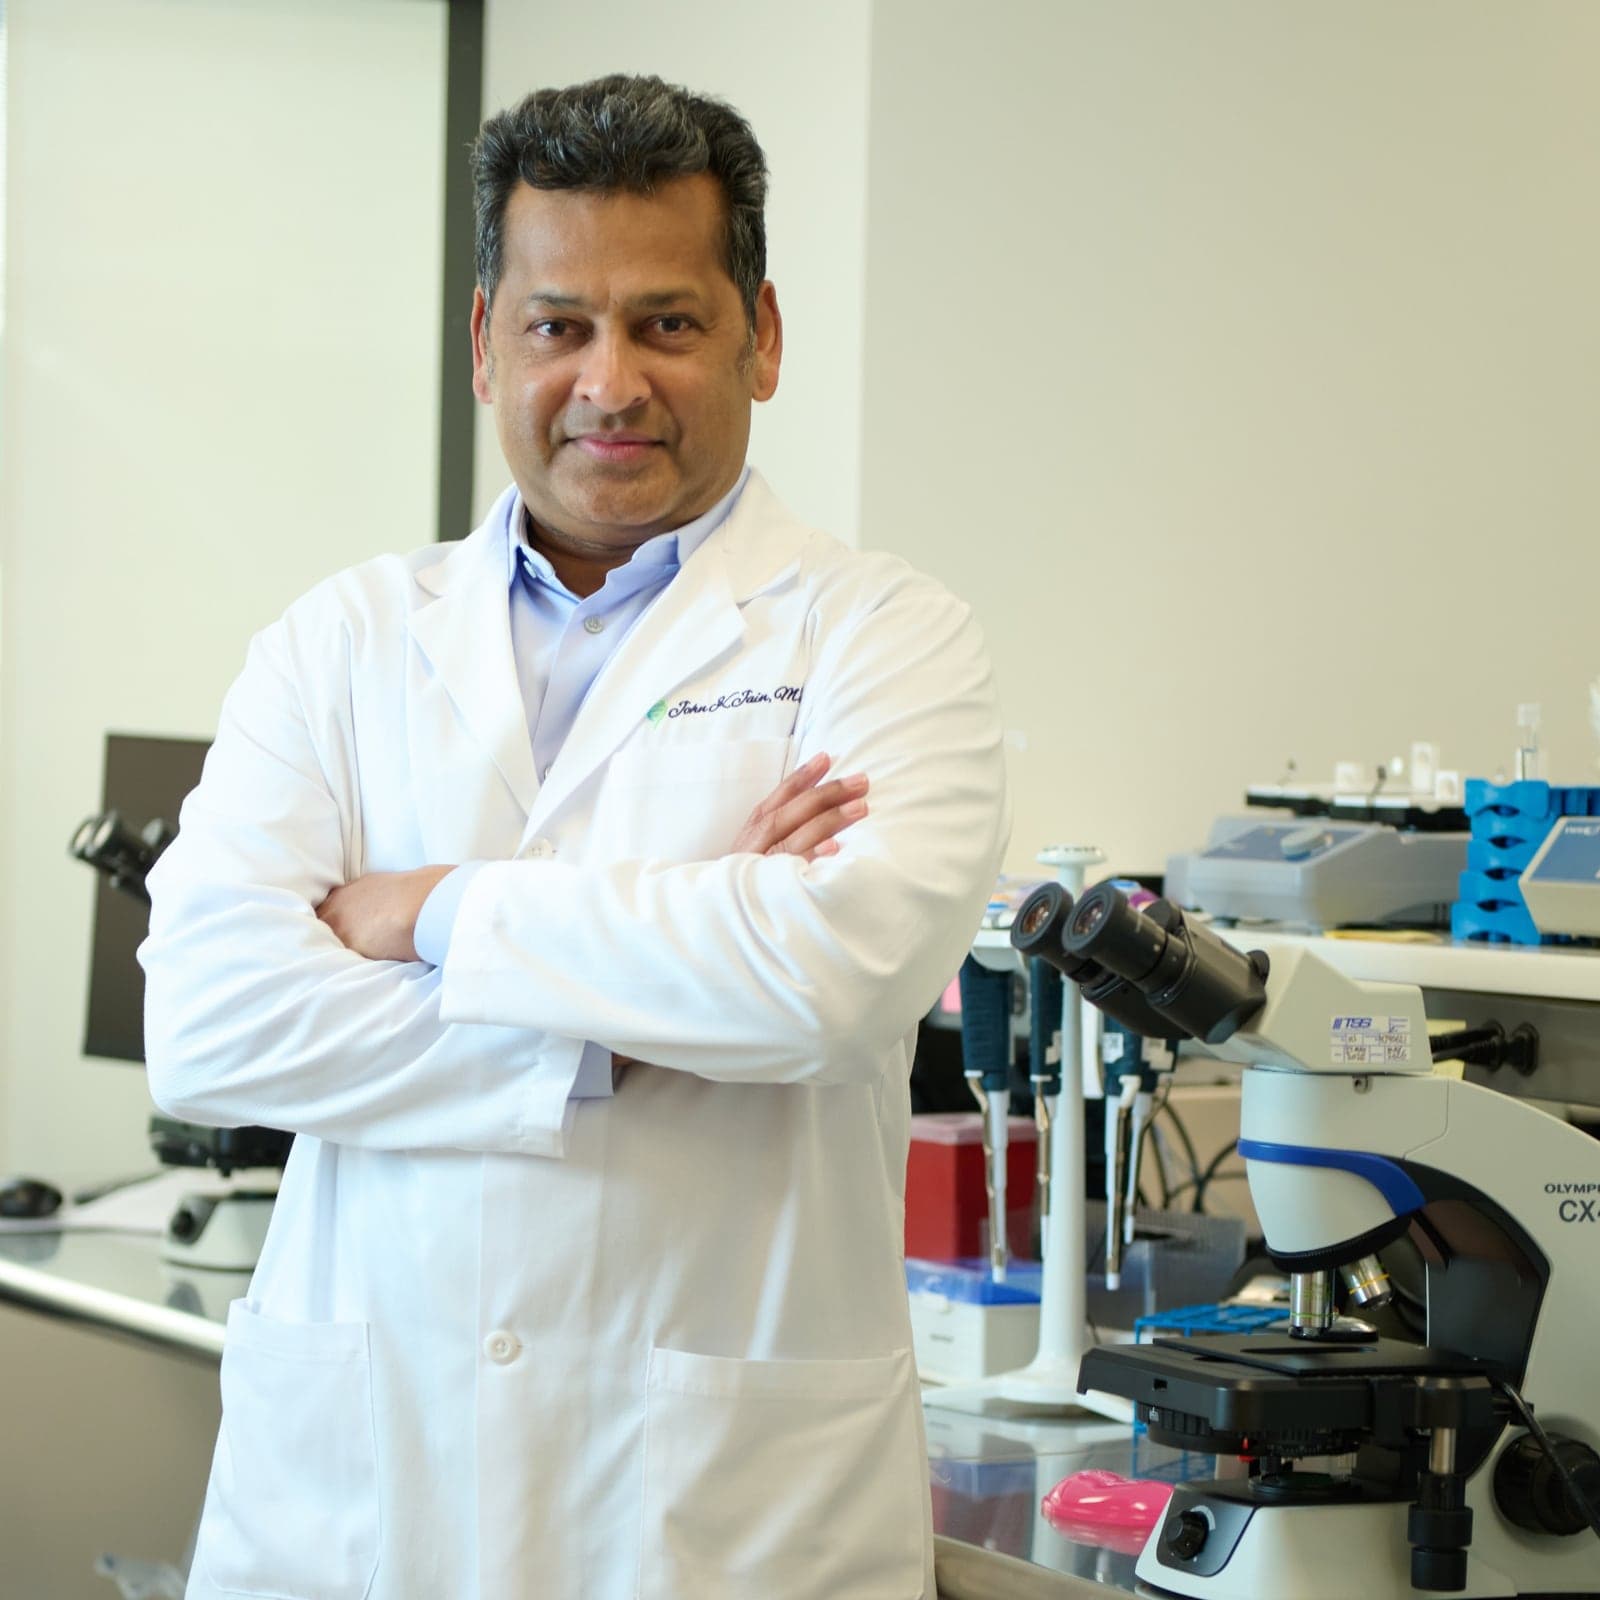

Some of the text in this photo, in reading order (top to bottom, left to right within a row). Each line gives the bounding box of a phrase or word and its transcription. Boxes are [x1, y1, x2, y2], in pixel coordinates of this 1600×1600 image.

[668, 700, 708, 718] John
[1544, 1183, 1600, 1194] OLYMP
[1558, 1199, 1600, 1223] CX
